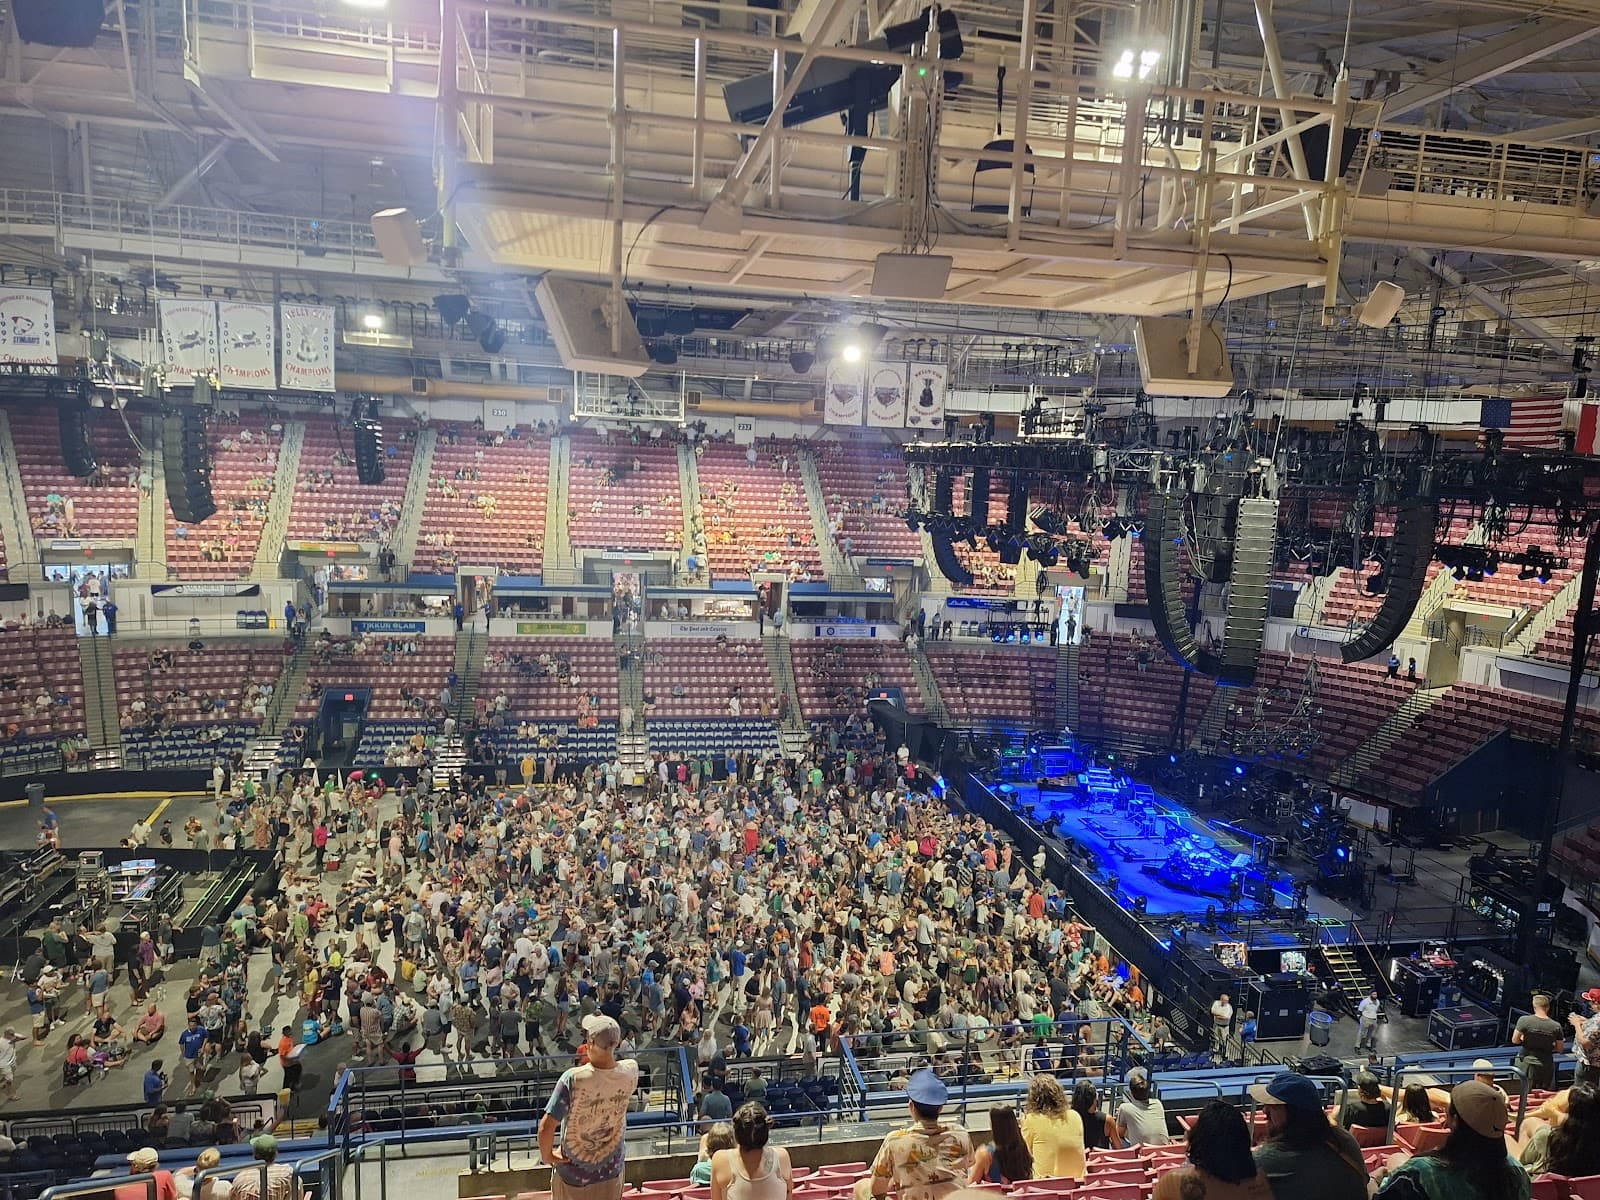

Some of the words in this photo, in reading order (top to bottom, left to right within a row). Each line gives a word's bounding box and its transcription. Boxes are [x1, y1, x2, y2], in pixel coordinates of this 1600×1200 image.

[3, 353, 53, 364] CHAMPIONS
[223, 364, 270, 378] CHAMPIONS
[285, 363, 331, 376] CHAMPIONS
